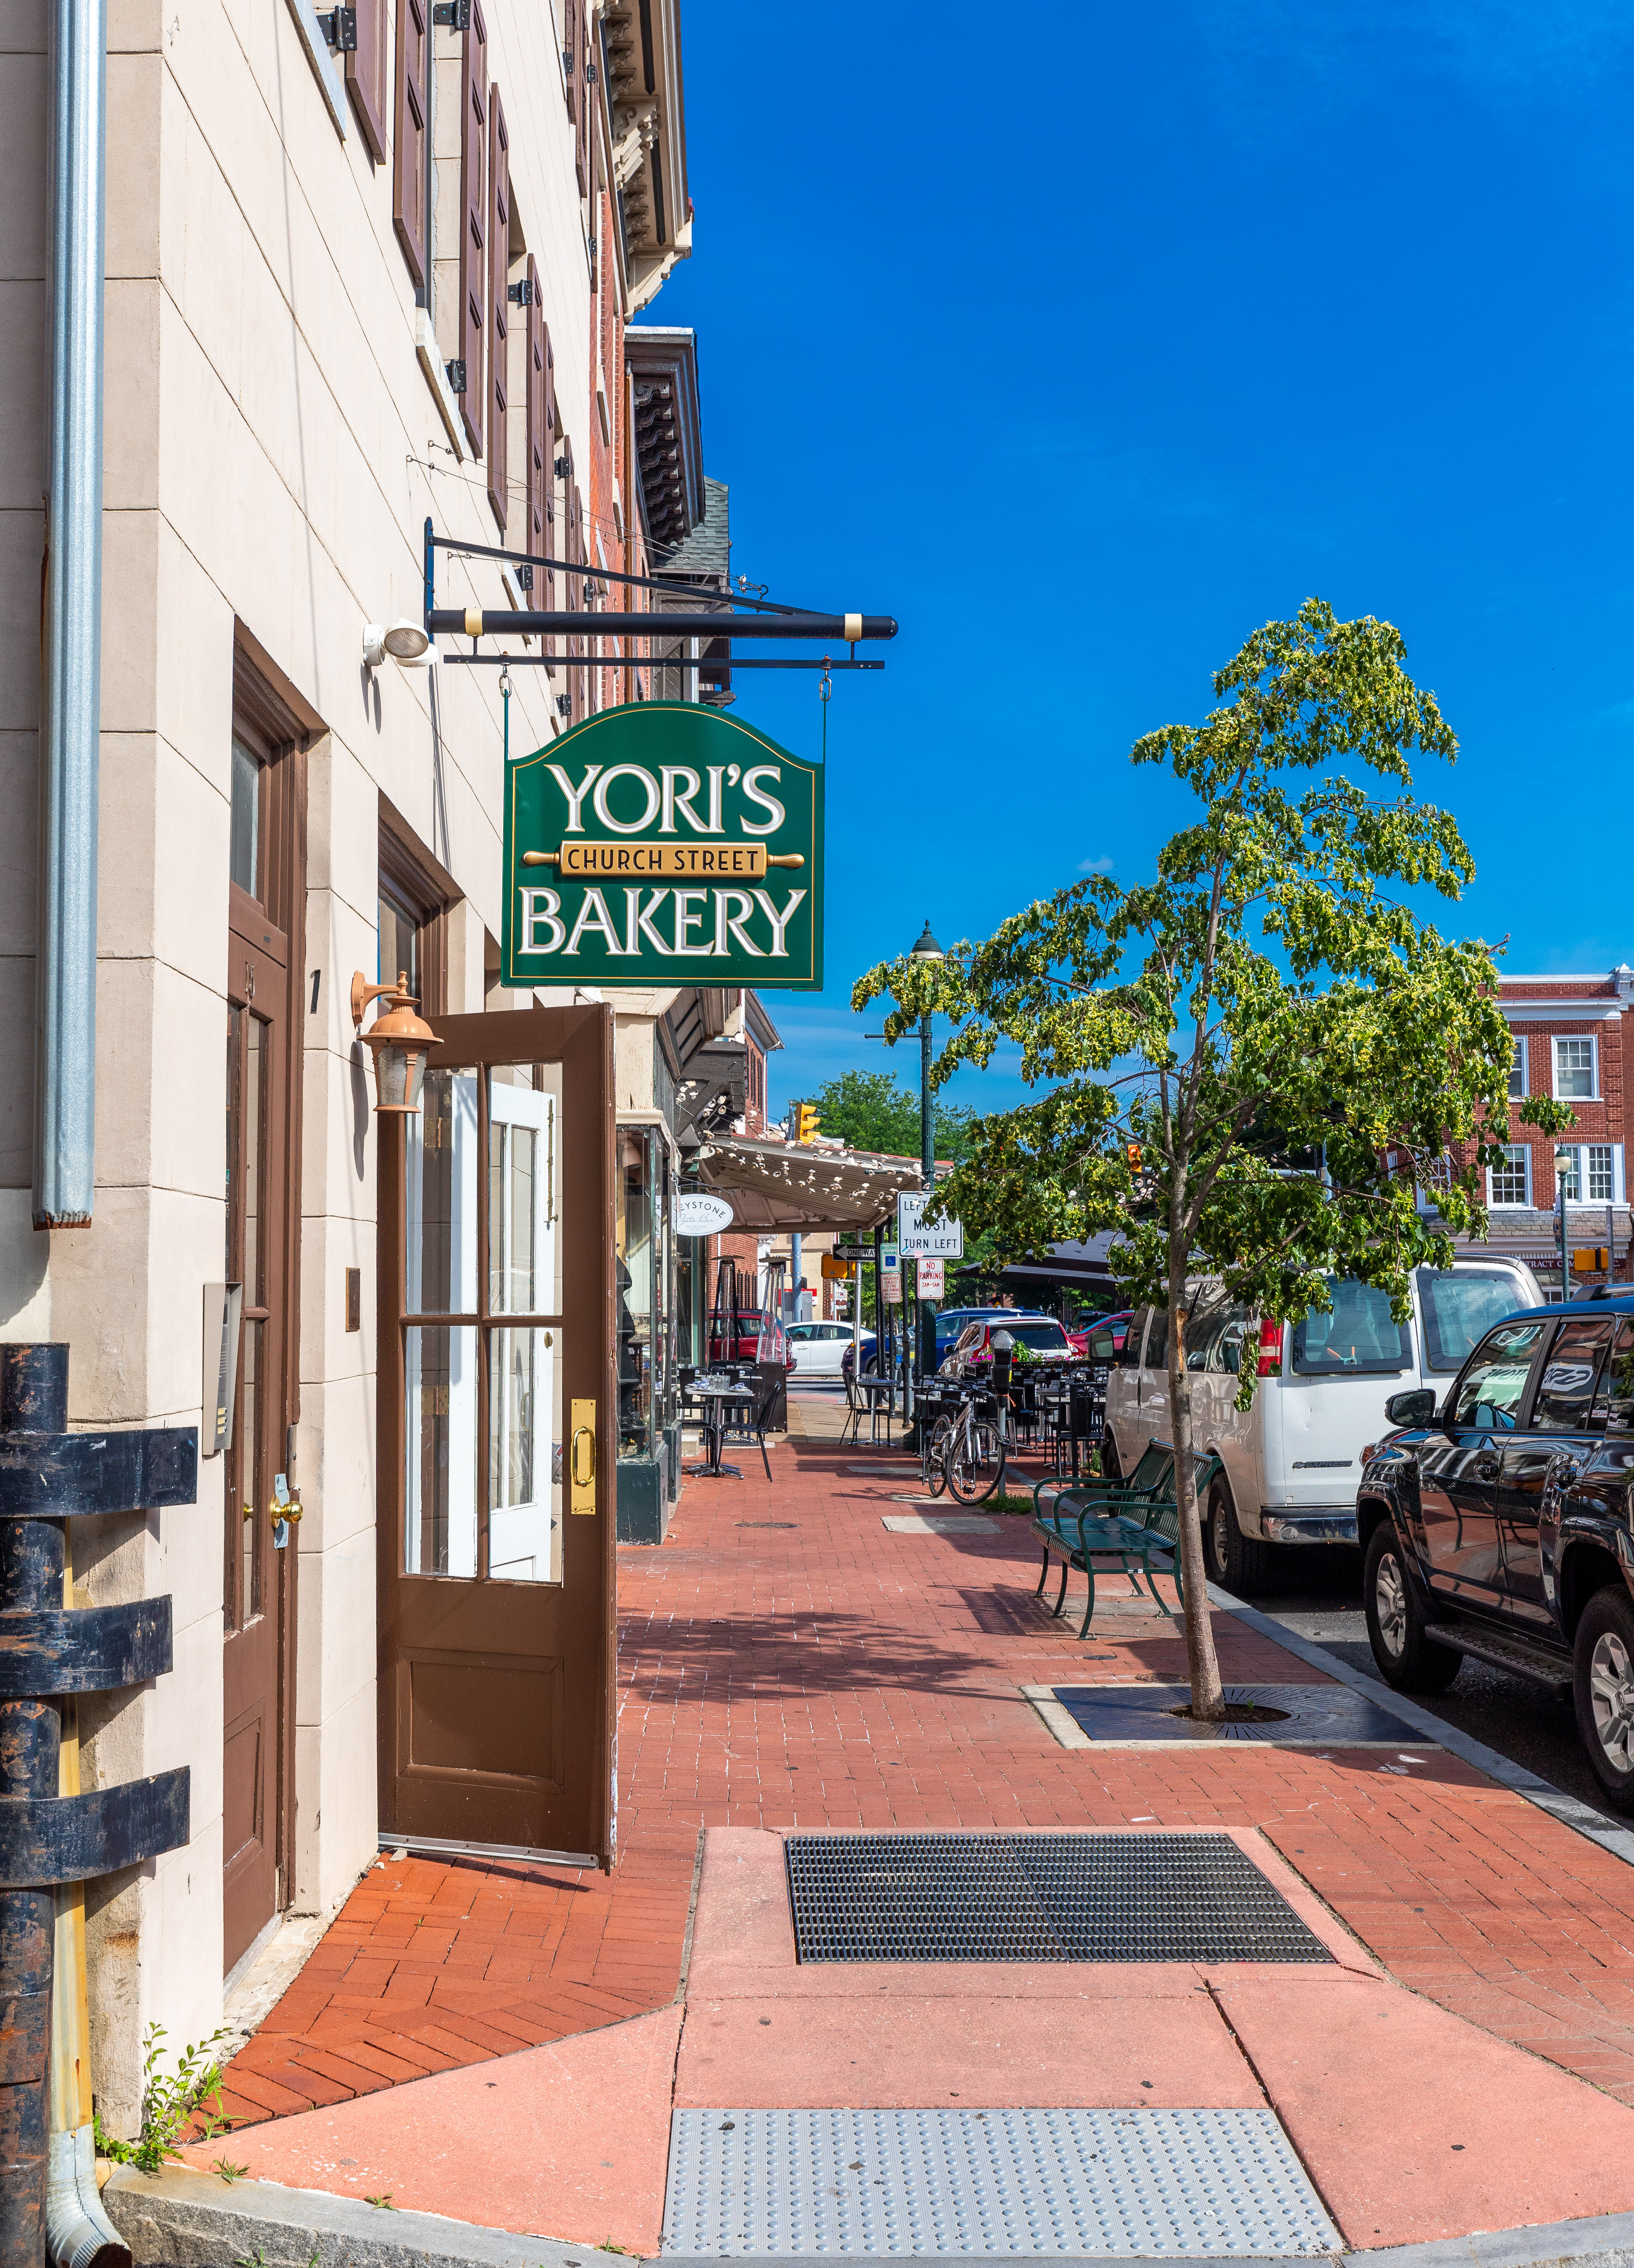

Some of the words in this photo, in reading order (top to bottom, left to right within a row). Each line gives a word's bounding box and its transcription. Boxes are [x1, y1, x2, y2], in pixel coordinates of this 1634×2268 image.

[543, 763, 786, 835] YORI'S
[567, 849, 662, 871] CHURCH
[674, 850, 759, 871] STREET
[517, 886, 808, 956] BAKERY
[681, 1202, 726, 1218] EYSTONE
[698, 1213, 714, 1222] Bar
[904, 1239, 929, 1249] TURN
[935, 1239, 957, 1249] LEFT
